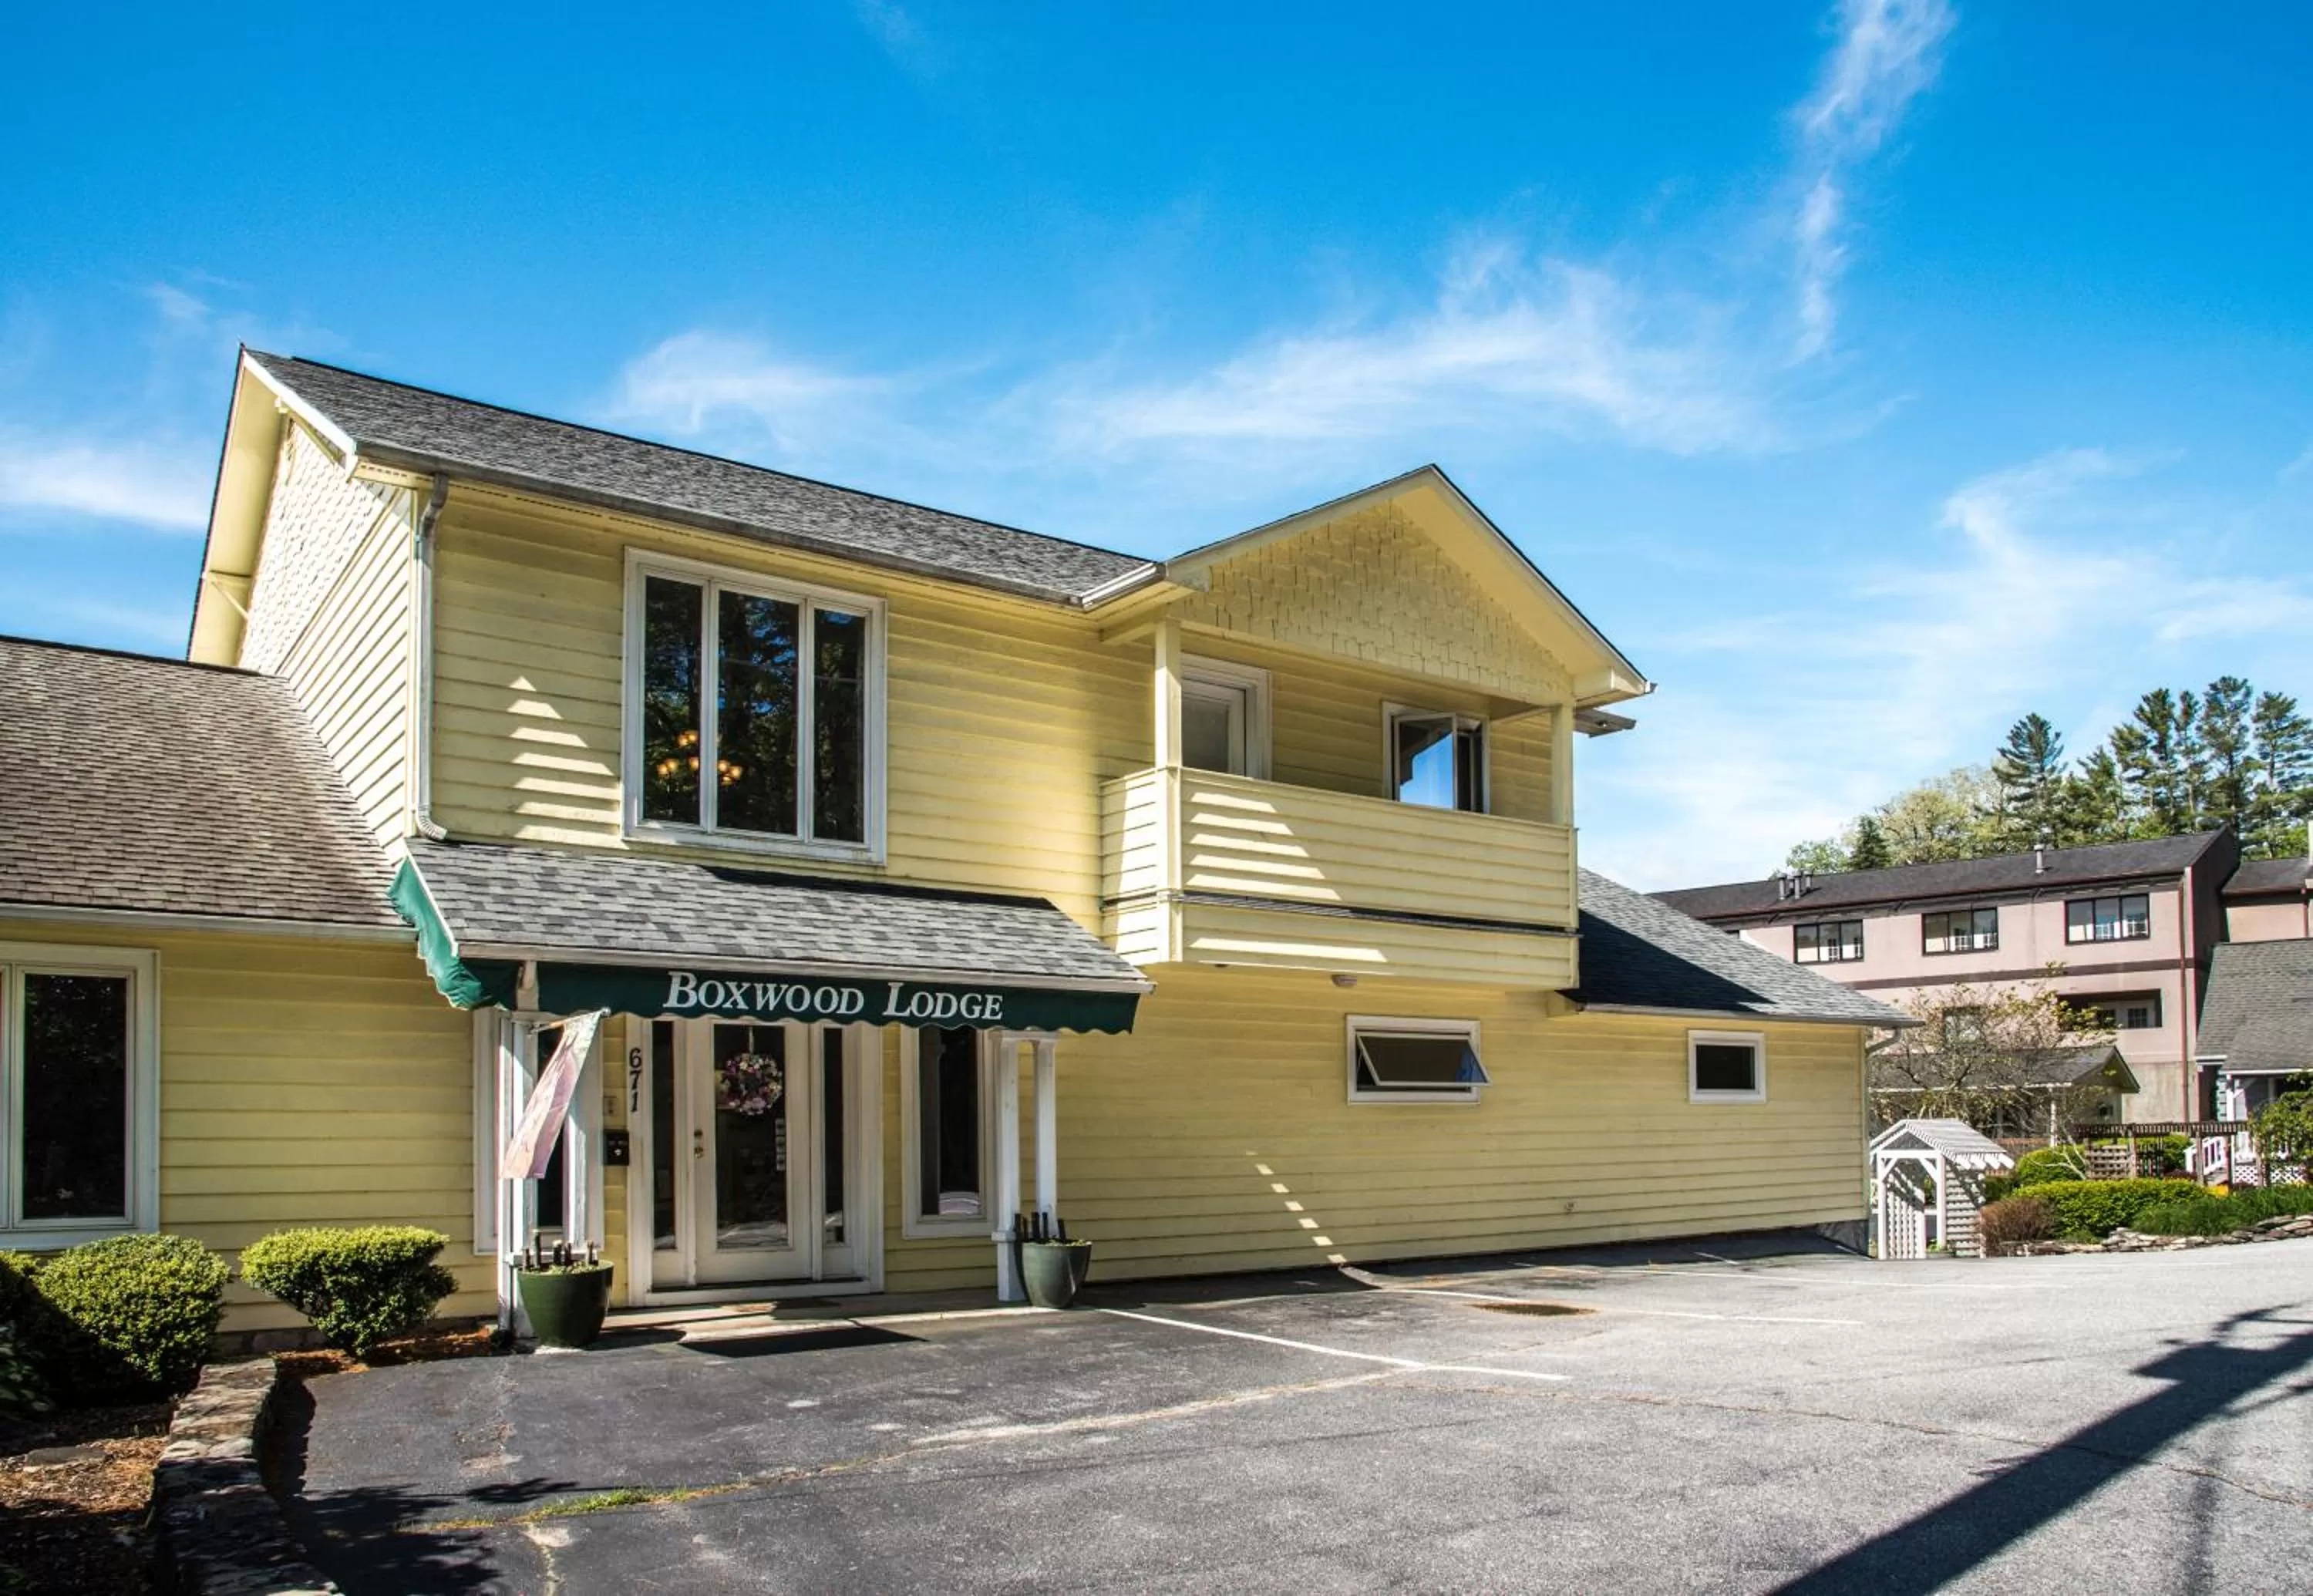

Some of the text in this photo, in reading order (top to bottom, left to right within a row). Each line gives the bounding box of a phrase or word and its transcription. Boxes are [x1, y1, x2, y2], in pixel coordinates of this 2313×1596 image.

[663, 971, 1003, 1020] BOXWOOD LODGE
[629, 1047, 641, 1112] 671
